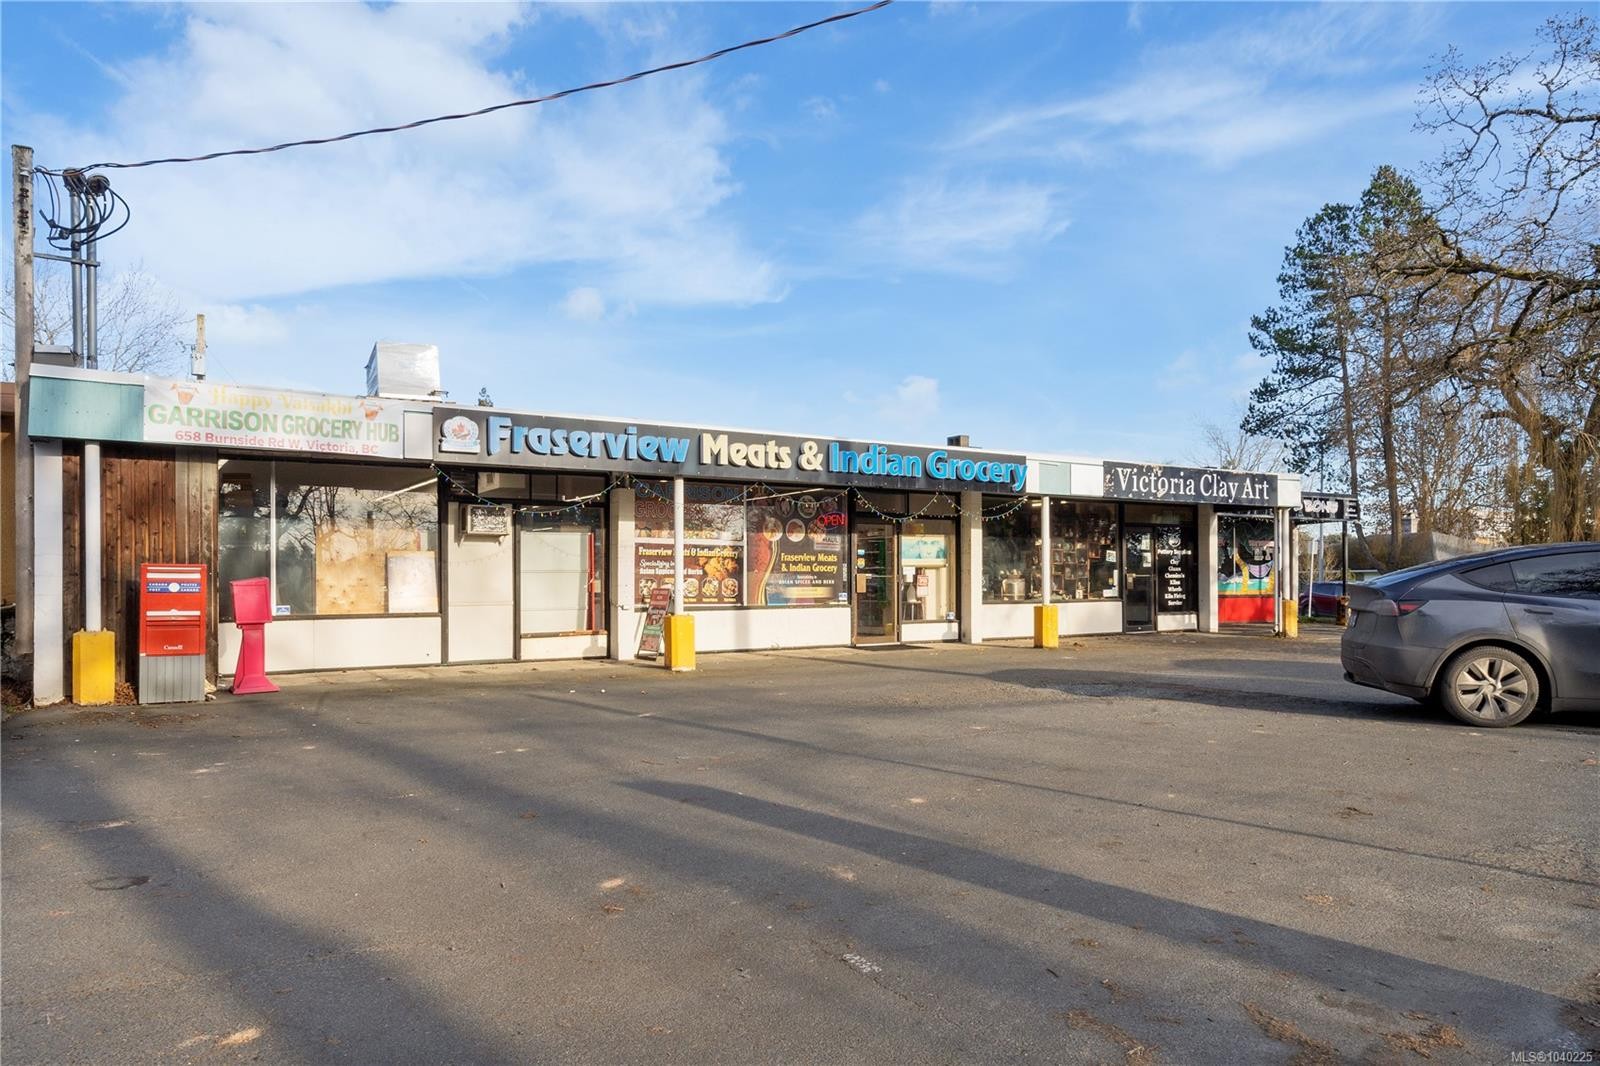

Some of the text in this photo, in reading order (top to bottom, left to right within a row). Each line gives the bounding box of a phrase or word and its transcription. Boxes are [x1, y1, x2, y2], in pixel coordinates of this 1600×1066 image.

[210, 384, 272, 410] Happy
[147, 403, 399, 443] GARRISON GROCERY HUB
[175, 430, 379, 455] 658 Burnside Rd W, Victoria, BC
[486, 415, 1028, 491] Fraserview Meats & Indian Grocery
[1116, 467, 1270, 503] Victoria Clay Art
[816, 514, 845, 528] OPEN
[781, 552, 837, 561] Fraserview Meats
[781, 563, 788, 571] &
[789, 563, 811, 571] Indian
[812, 563, 837, 574] Grocery
